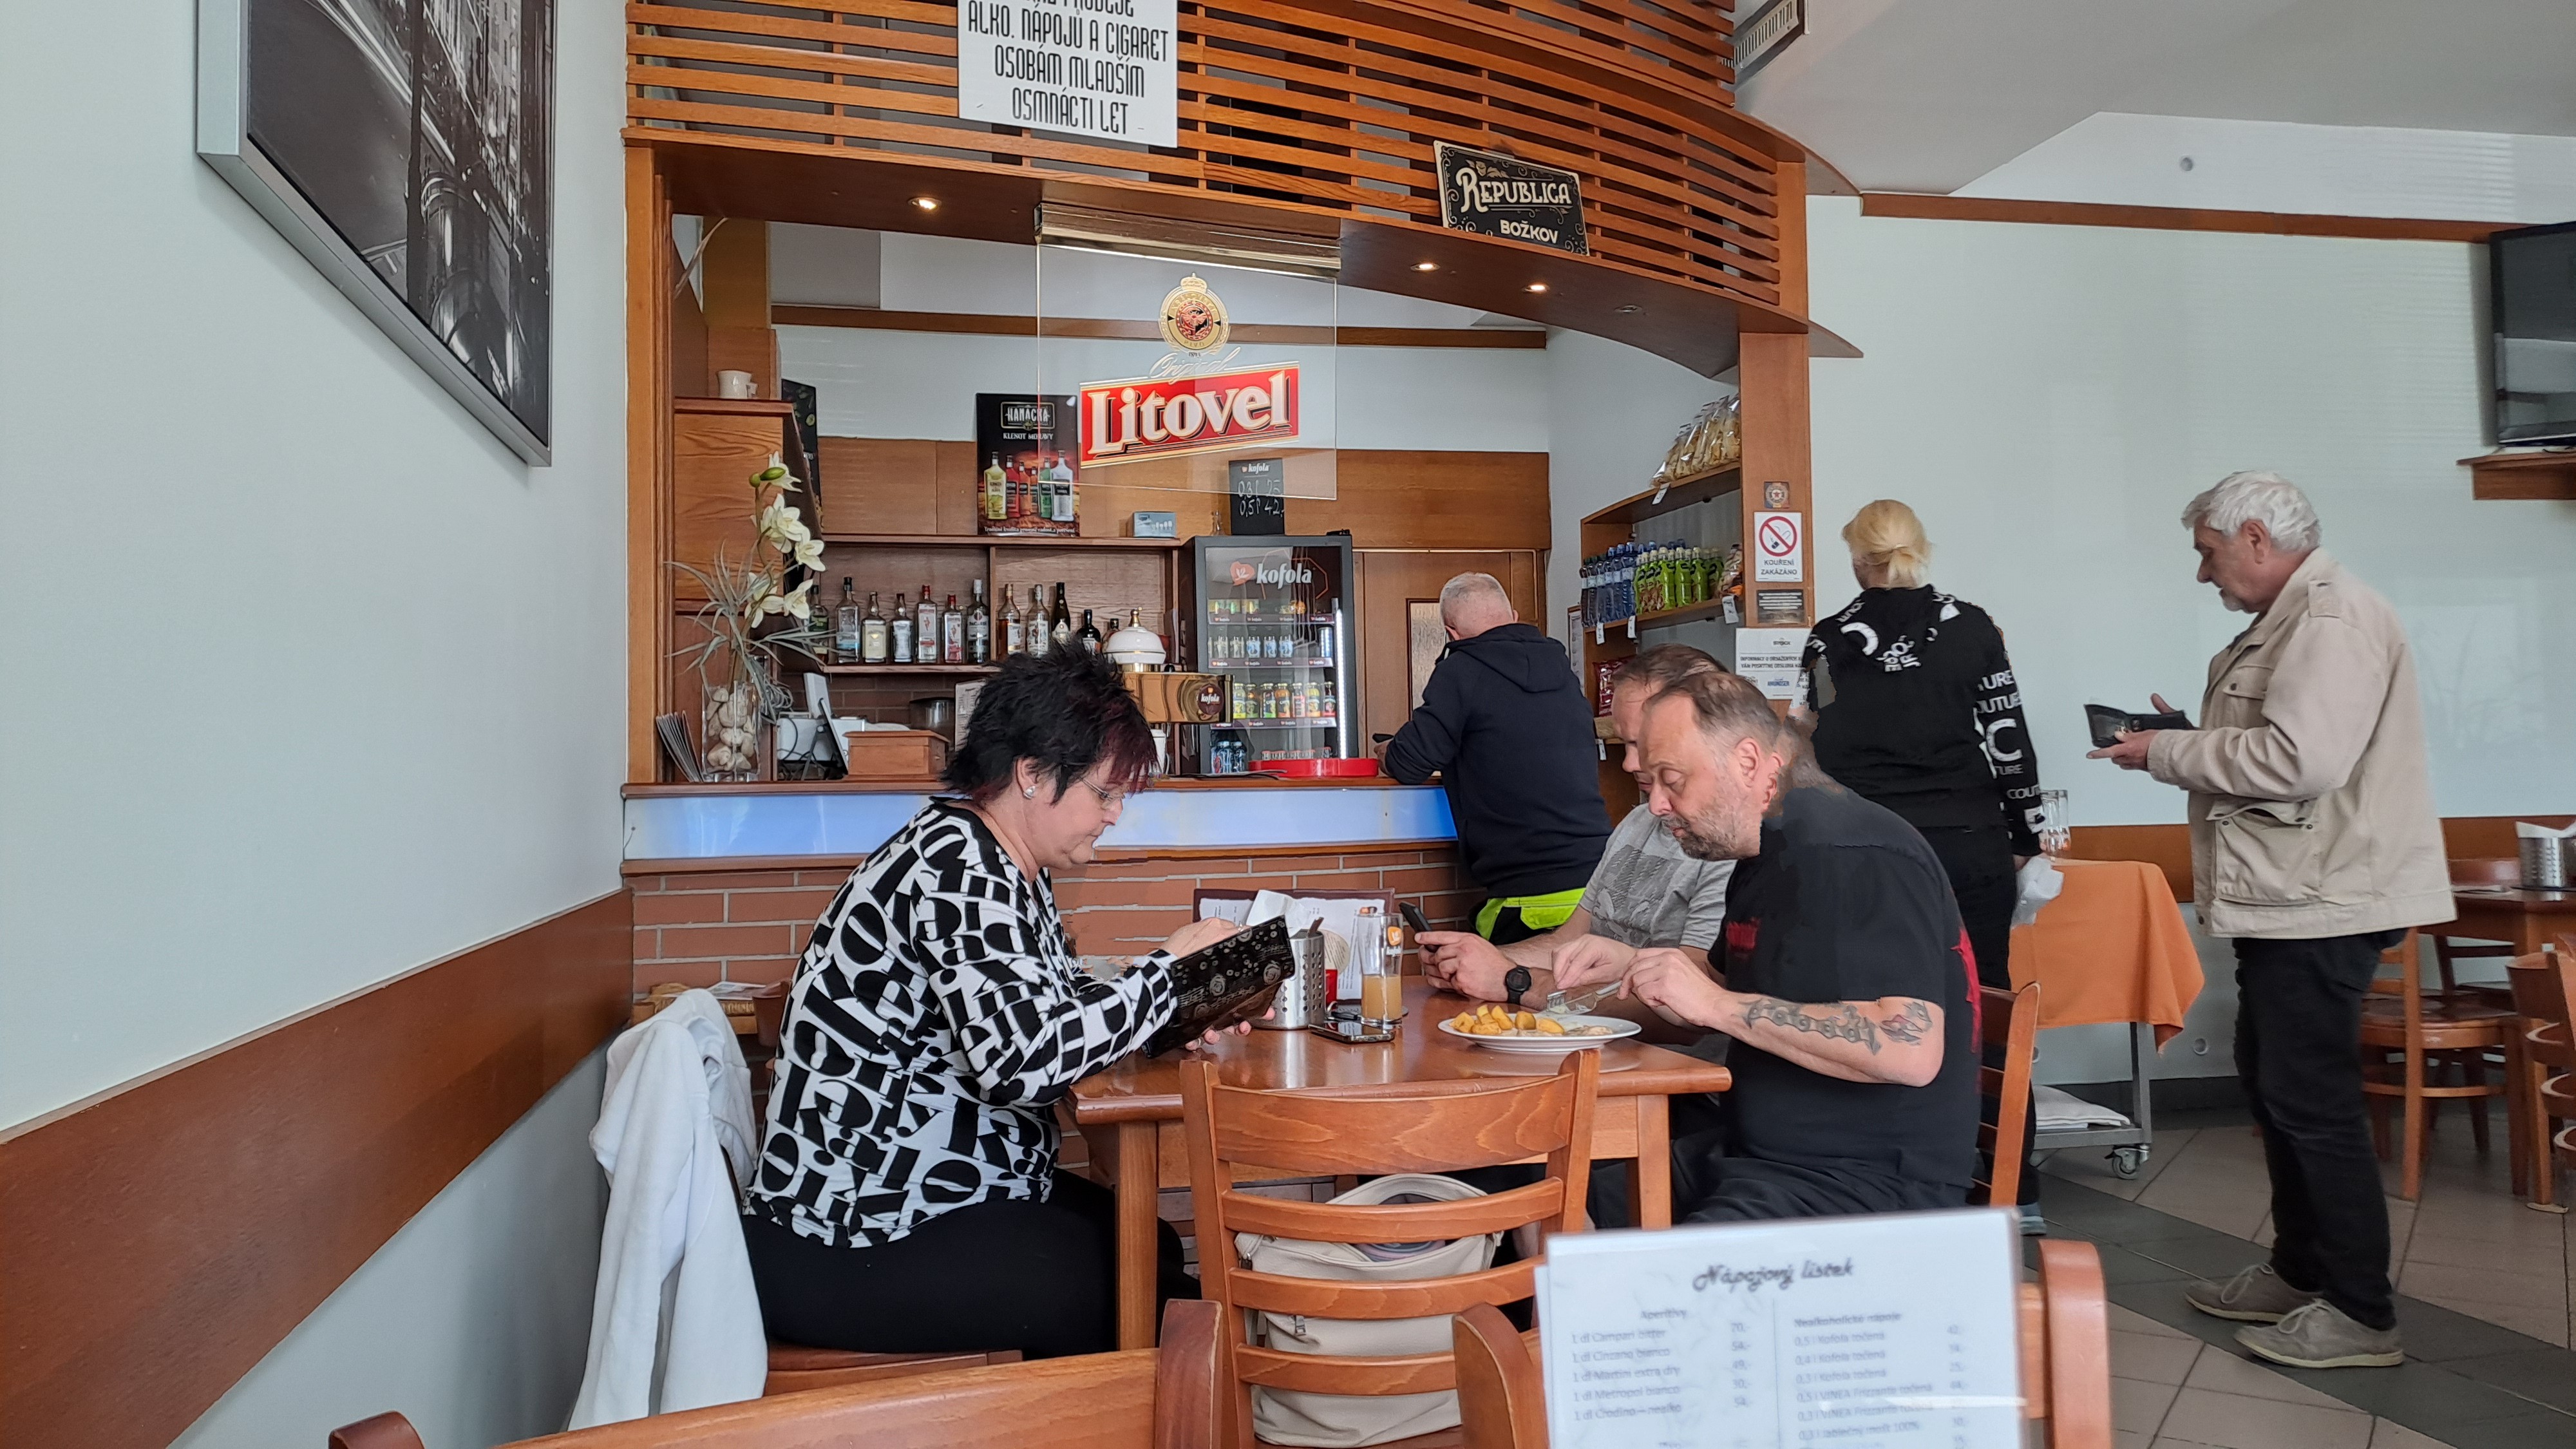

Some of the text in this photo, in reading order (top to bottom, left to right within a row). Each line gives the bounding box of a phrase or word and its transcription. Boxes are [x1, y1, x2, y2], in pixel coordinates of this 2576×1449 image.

[968, 0, 1168, 62] ALKO. NÁPOJŮ A CIGARET
[995, 43, 1144, 97] OSOBÁM MLADŠÍM
[1012, 86, 1129, 134] OSMNÁCTI LET
[1455, 167, 1572, 213] REPUBLICA
[1500, 219, 1558, 243] BOŽKOV
[1087, 370, 1291, 456] Litovel
[1248, 462, 1270, 474] kofola
[1256, 562, 1312, 589] kofola
[1200, 694, 1220, 705] kofola
